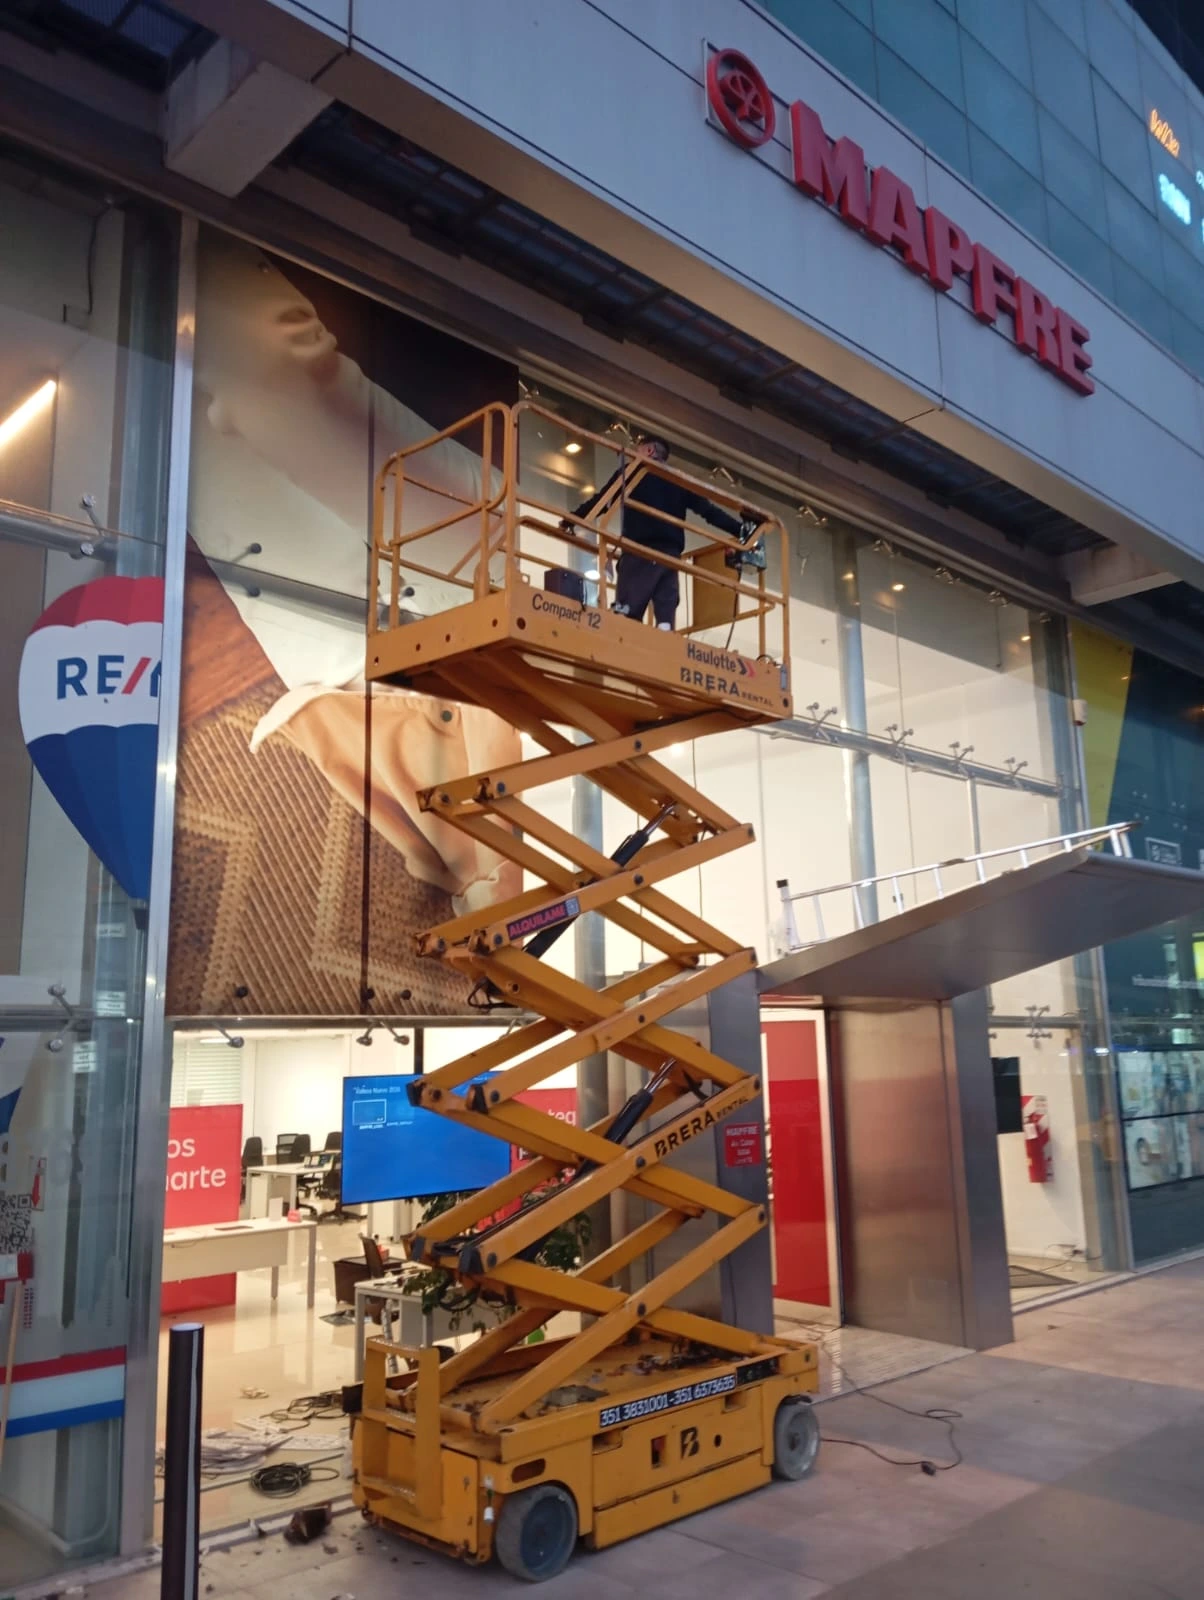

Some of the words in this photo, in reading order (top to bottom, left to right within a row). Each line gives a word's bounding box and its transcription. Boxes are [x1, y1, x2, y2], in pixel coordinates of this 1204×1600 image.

[790, 99, 1095, 397] MAPFRE
[532, 593, 582, 622] Compact
[587, 612, 601, 629] 12
[687, 643, 736, 672] Haulotte
[680, 667, 740, 697] BRERA
[655, 1110, 715, 1157] BRERA
[166, 1165, 226, 1192] arte
[601, 1409, 621, 1426] 351
[674, 1387, 693, 1405] 351
